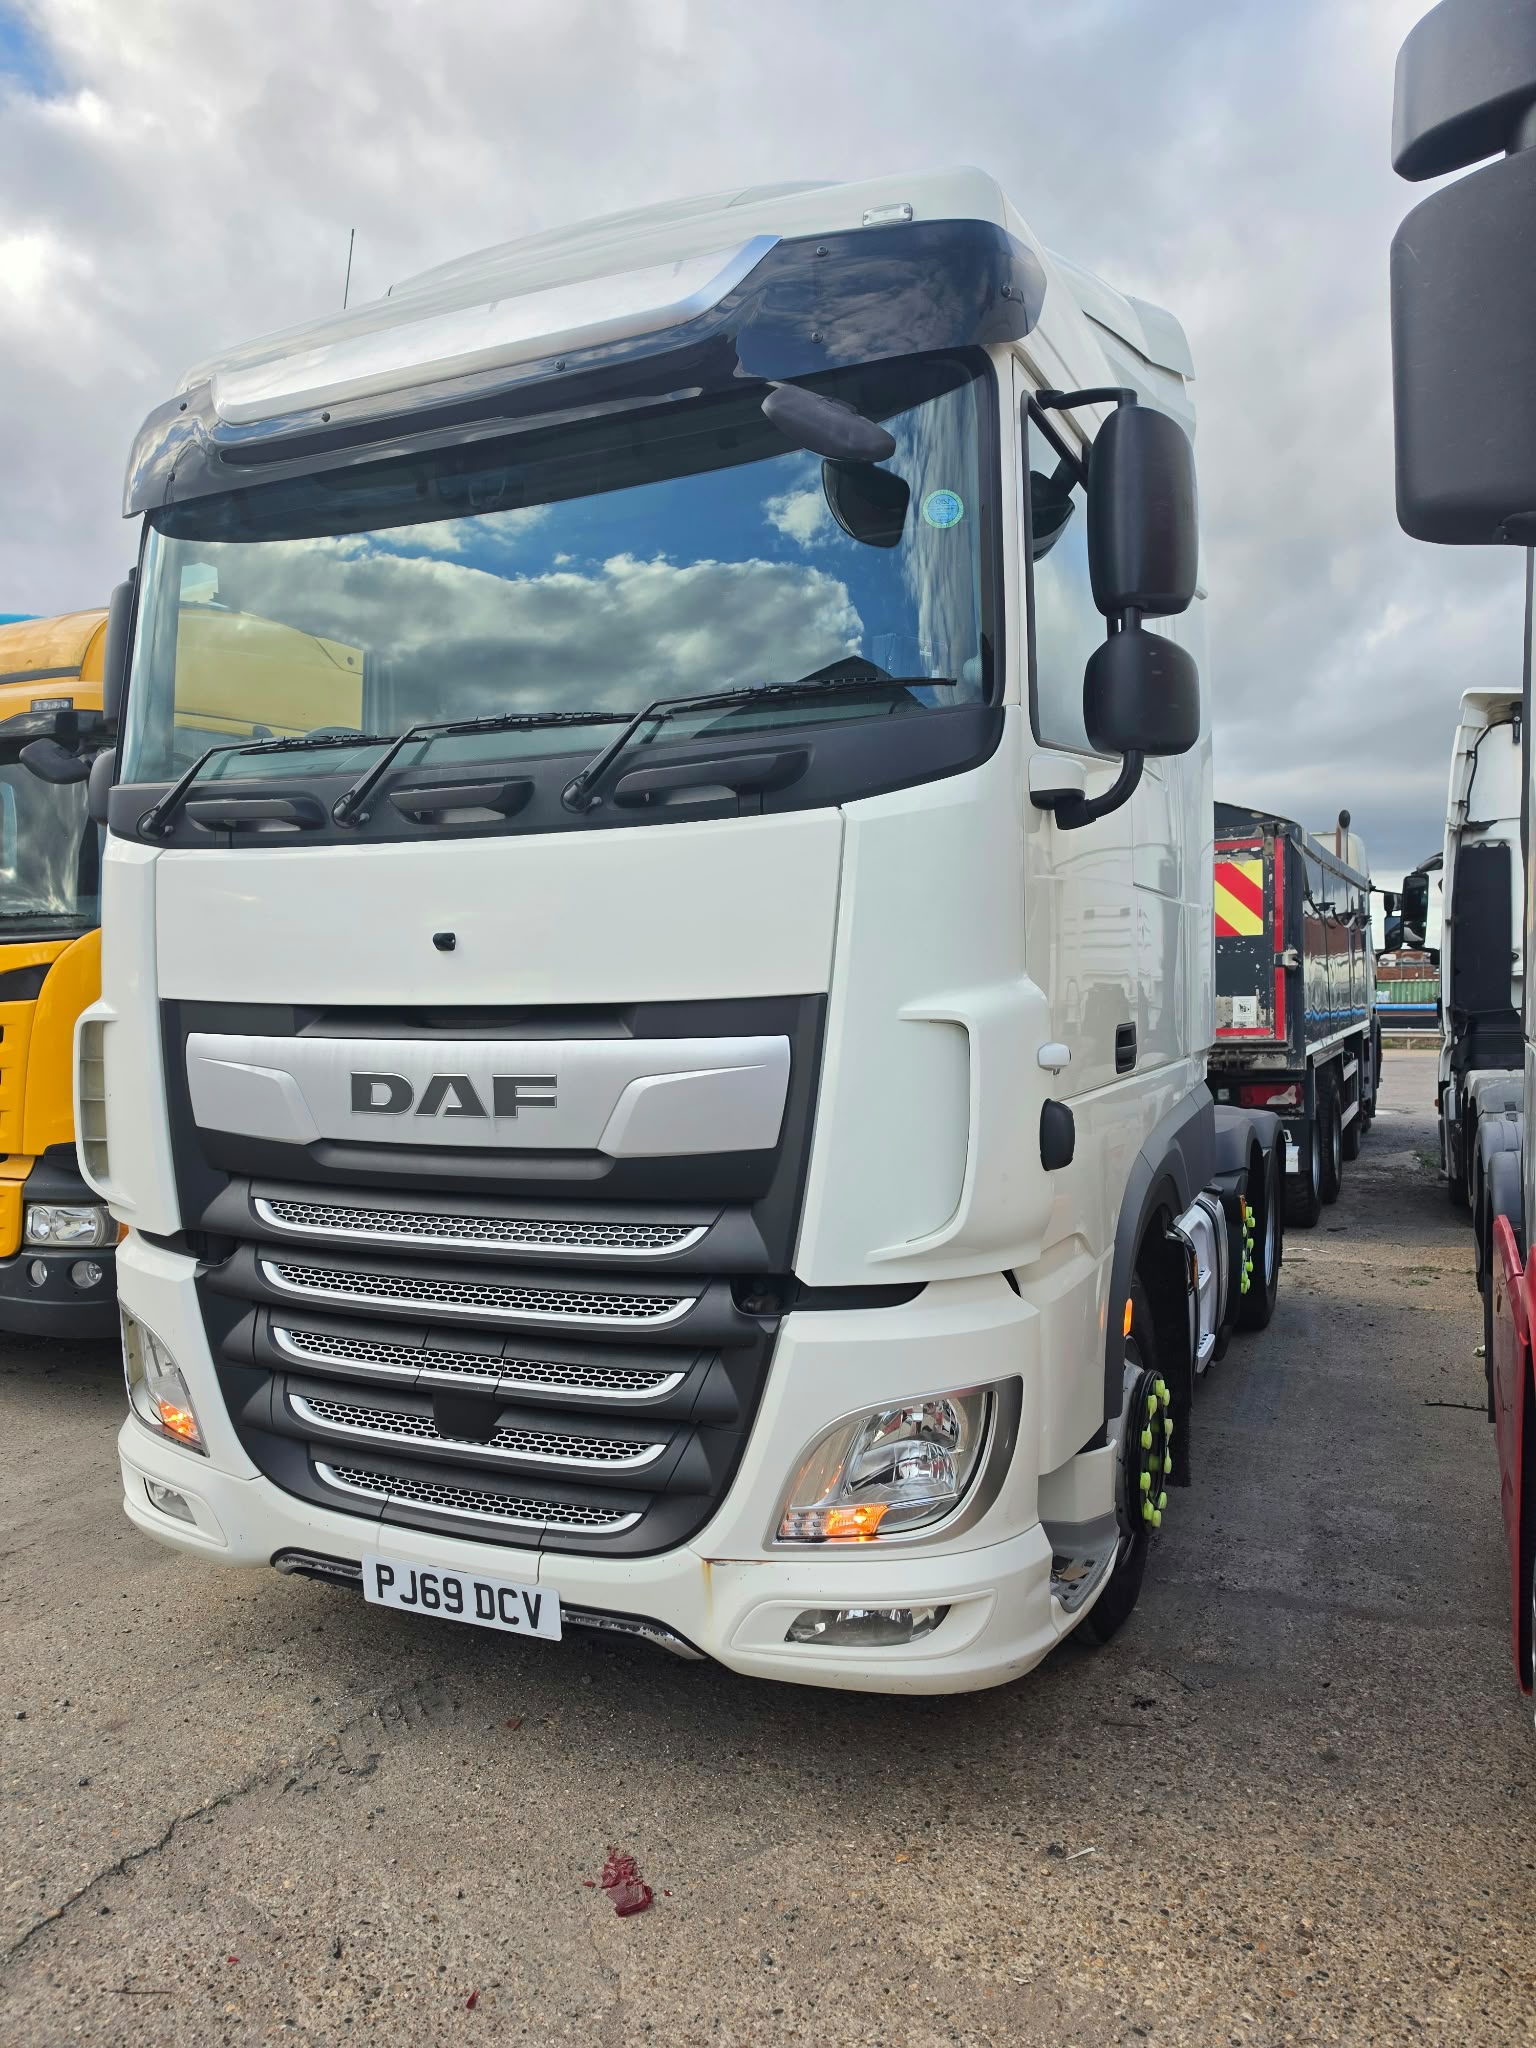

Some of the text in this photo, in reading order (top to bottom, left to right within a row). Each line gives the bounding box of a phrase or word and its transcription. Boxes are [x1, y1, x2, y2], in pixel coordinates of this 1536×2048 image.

[350, 1071, 557, 1118] DAF
[375, 1563, 542, 1630] PJ69 DCV
